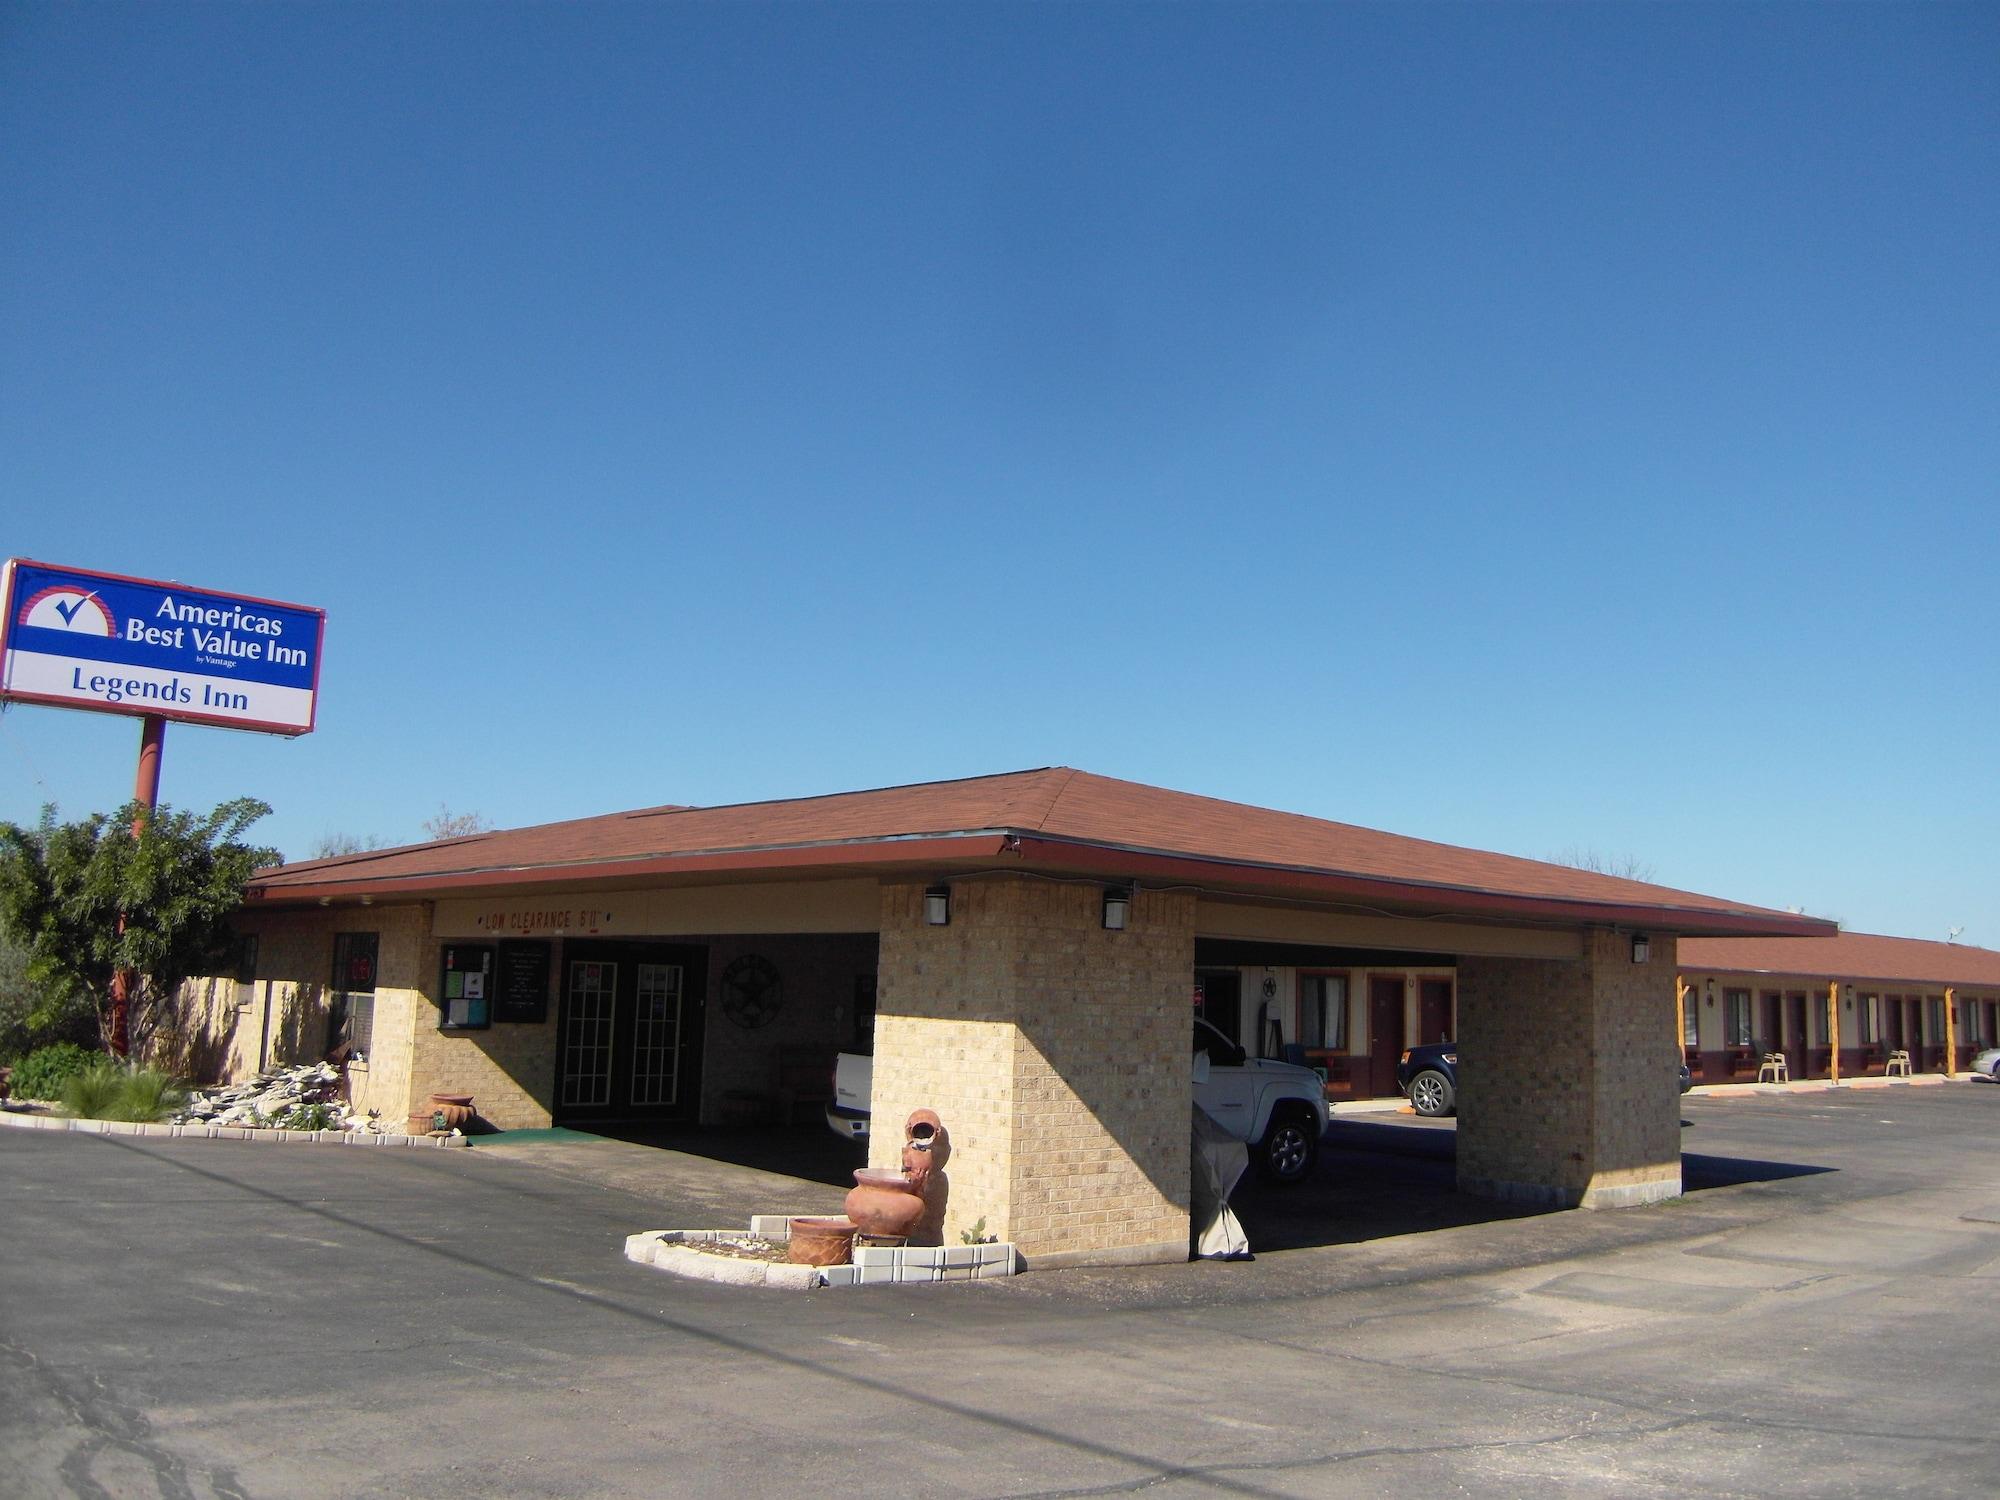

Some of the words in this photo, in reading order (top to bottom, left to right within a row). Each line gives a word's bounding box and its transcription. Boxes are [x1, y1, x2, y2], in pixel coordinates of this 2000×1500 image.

[156, 596, 283, 636] Americas
[126, 618, 184, 649] Best
[192, 628, 261, 659] Value
[267, 640, 307, 666] Inn
[196, 655, 205, 664] by
[205, 655, 237, 669] Vantage
[73, 667, 191, 703] Legends
[203, 684, 248, 710] Inn
[485, 912, 506, 929] LOW
[511, 910, 572, 929] CLEARANCE
